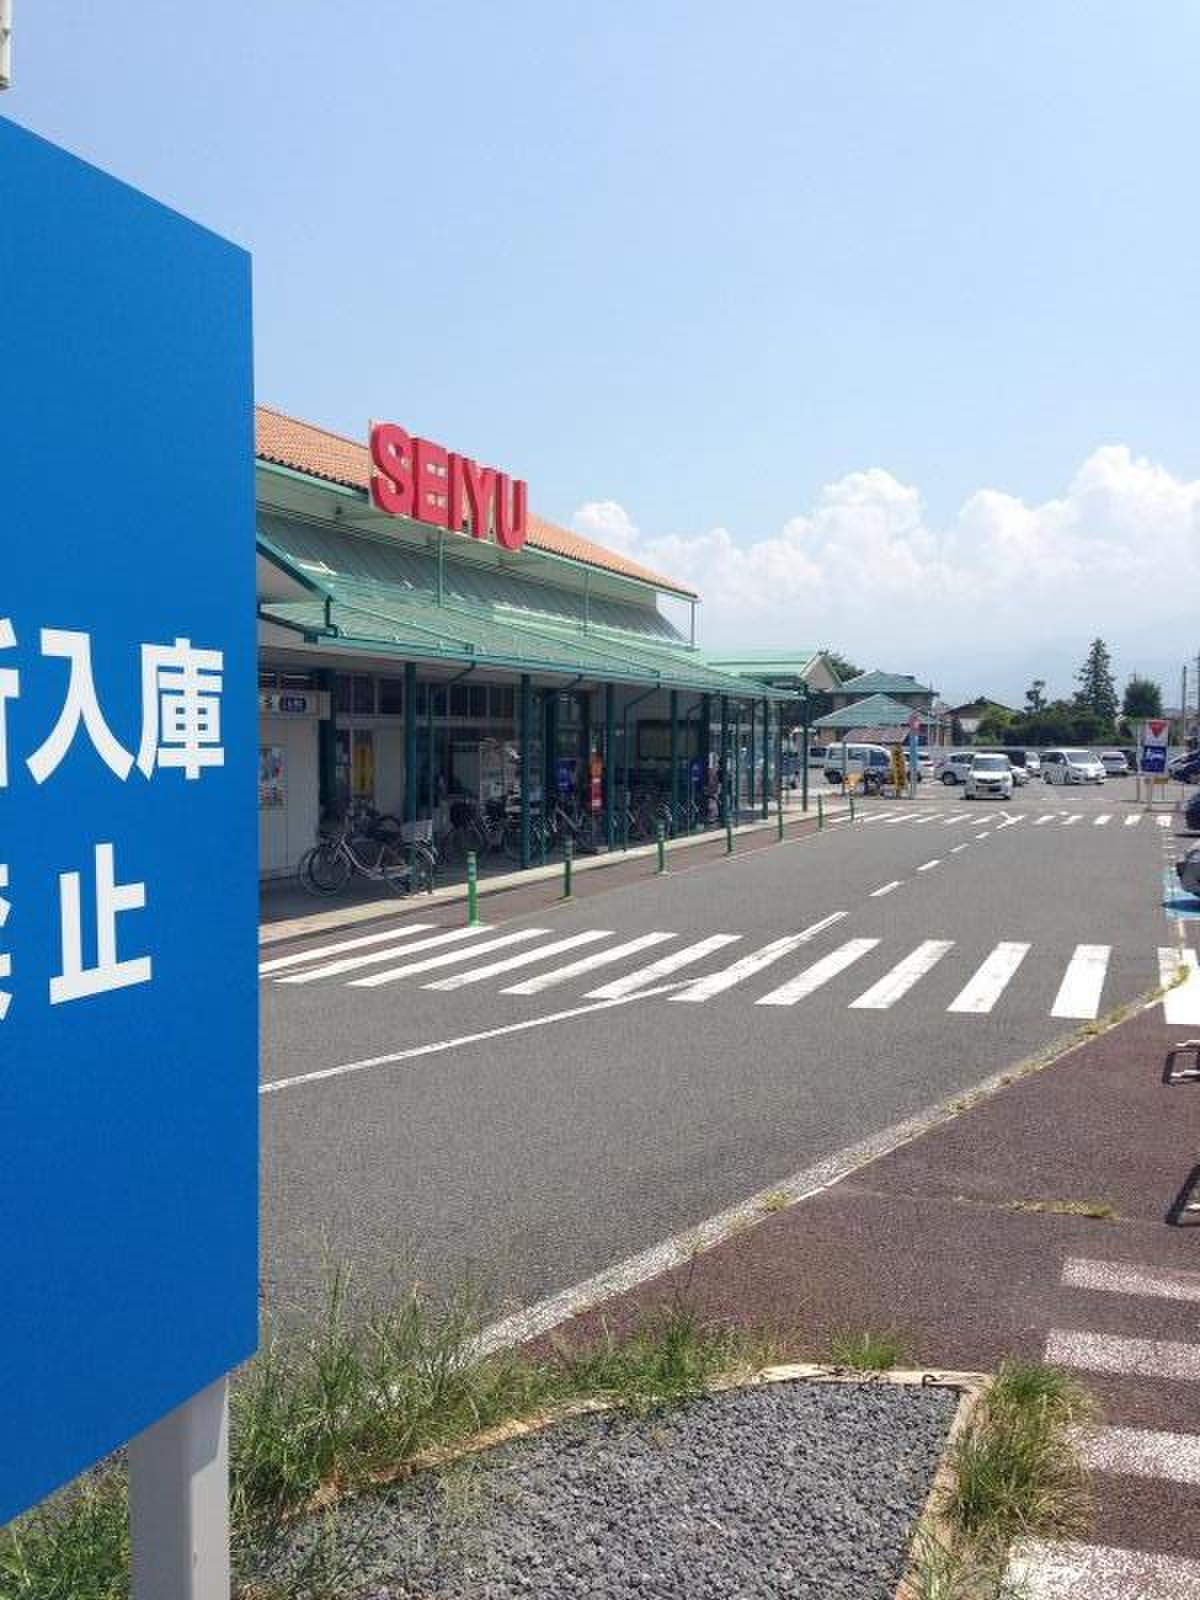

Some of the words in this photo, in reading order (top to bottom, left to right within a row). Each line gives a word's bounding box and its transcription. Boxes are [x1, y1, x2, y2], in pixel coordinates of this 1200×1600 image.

[370, 423, 527, 550] SEIYU
[0, 617, 225, 786] 入庫
[0, 843, 152, 1021] 止
